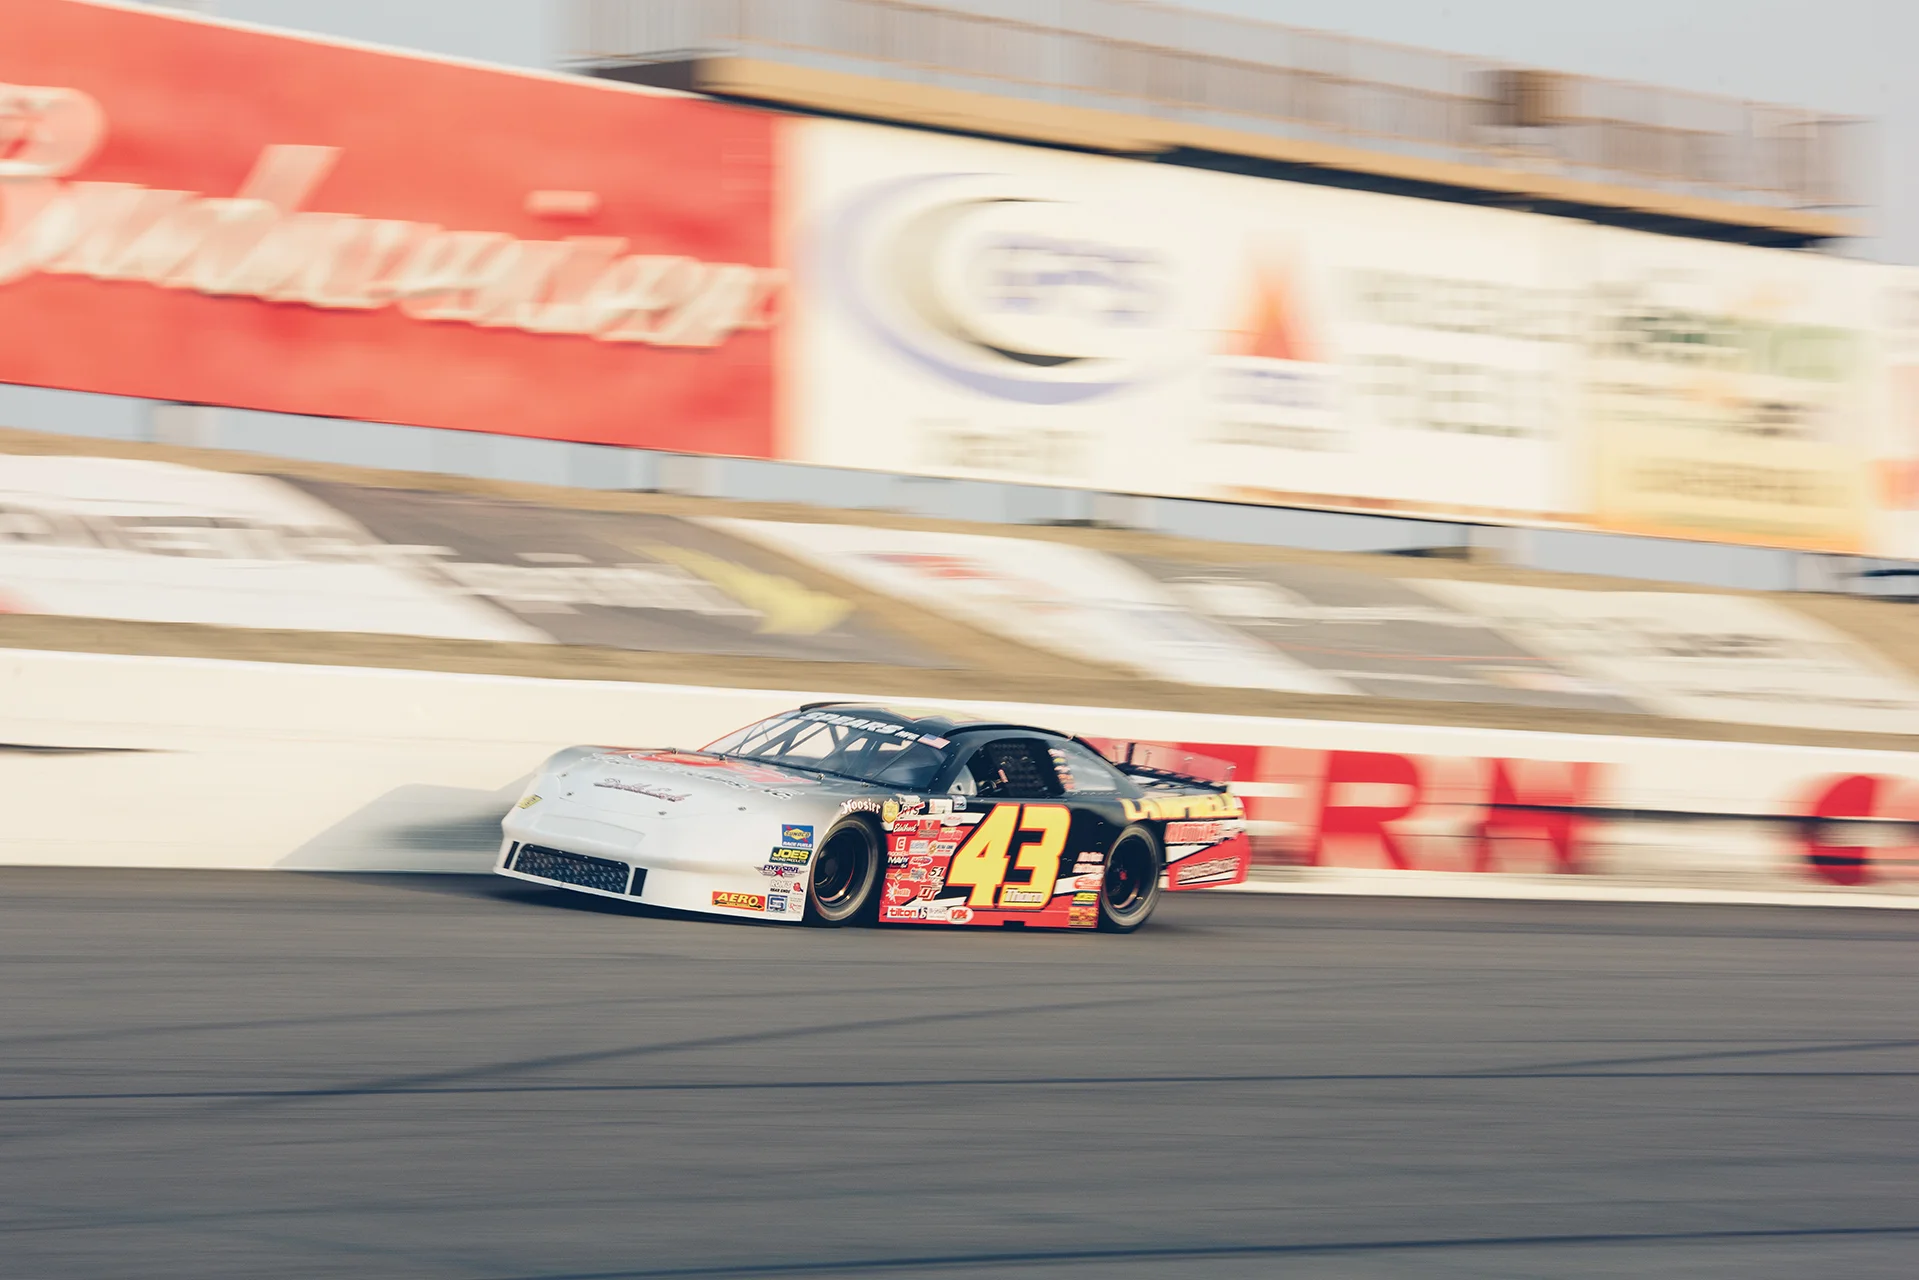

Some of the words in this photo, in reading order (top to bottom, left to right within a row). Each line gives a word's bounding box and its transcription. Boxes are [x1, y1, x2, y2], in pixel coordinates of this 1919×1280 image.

[799, 711, 904, 734] SPEARS
[840, 798, 882, 816] Hoosier
[785, 830, 810, 838] SUNOCO
[772, 848, 810, 860] JOES
[945, 802, 1072, 909] 43
[717, 892, 759, 906] AERO
[889, 907, 918, 918] tilton
